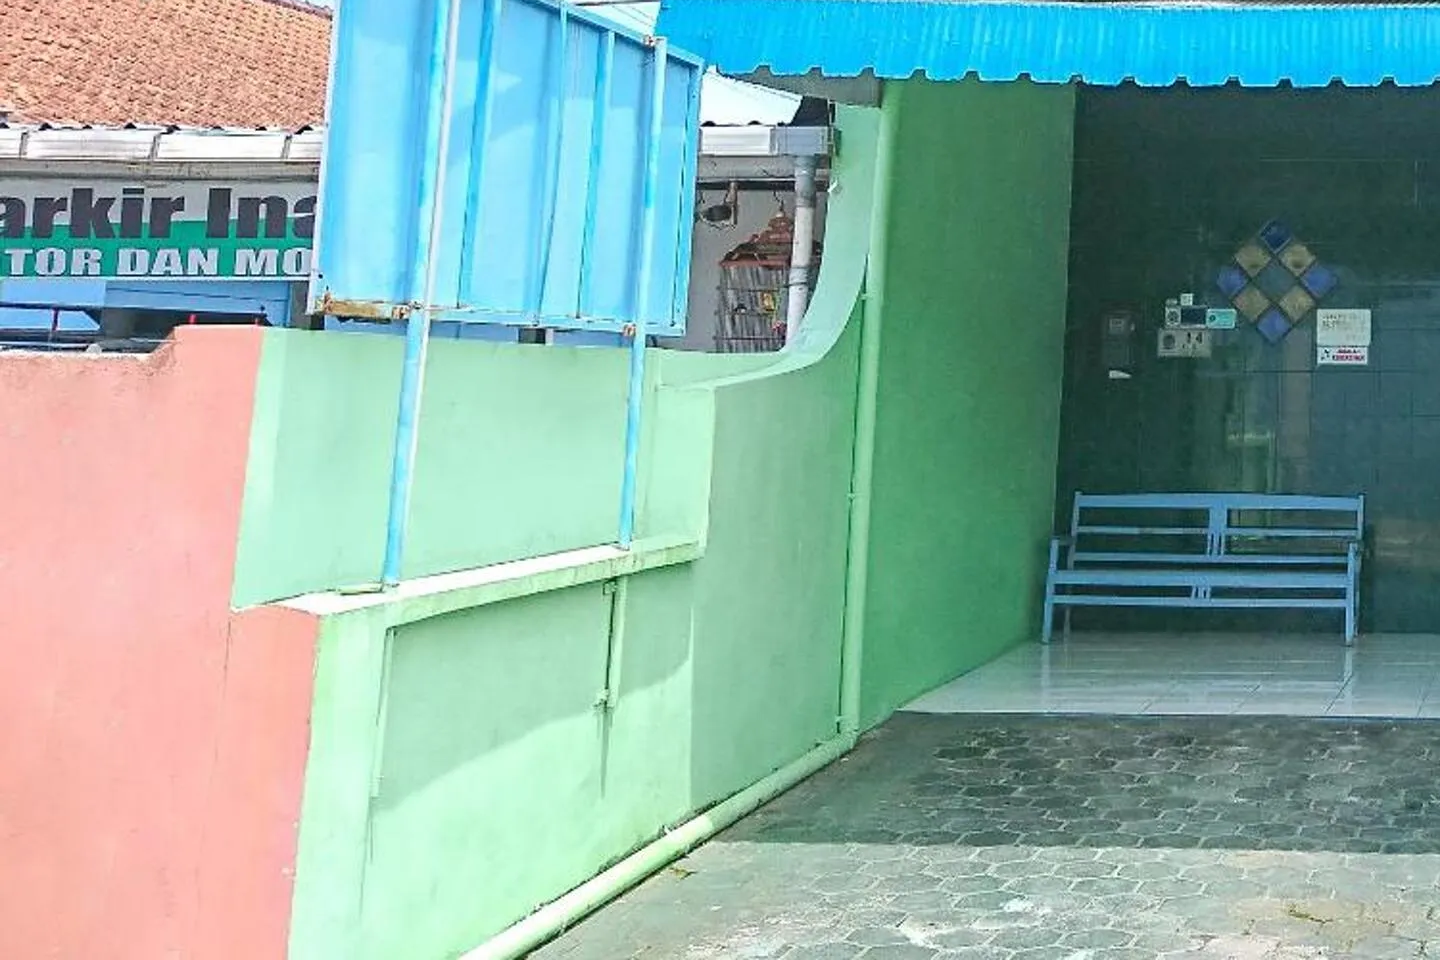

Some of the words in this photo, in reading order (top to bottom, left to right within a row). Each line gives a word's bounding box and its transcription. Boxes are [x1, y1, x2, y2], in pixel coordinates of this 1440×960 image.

[5, 247, 101, 276] TOR
[116, 247, 219, 276] DAN
[234, 247, 312, 276] MO
